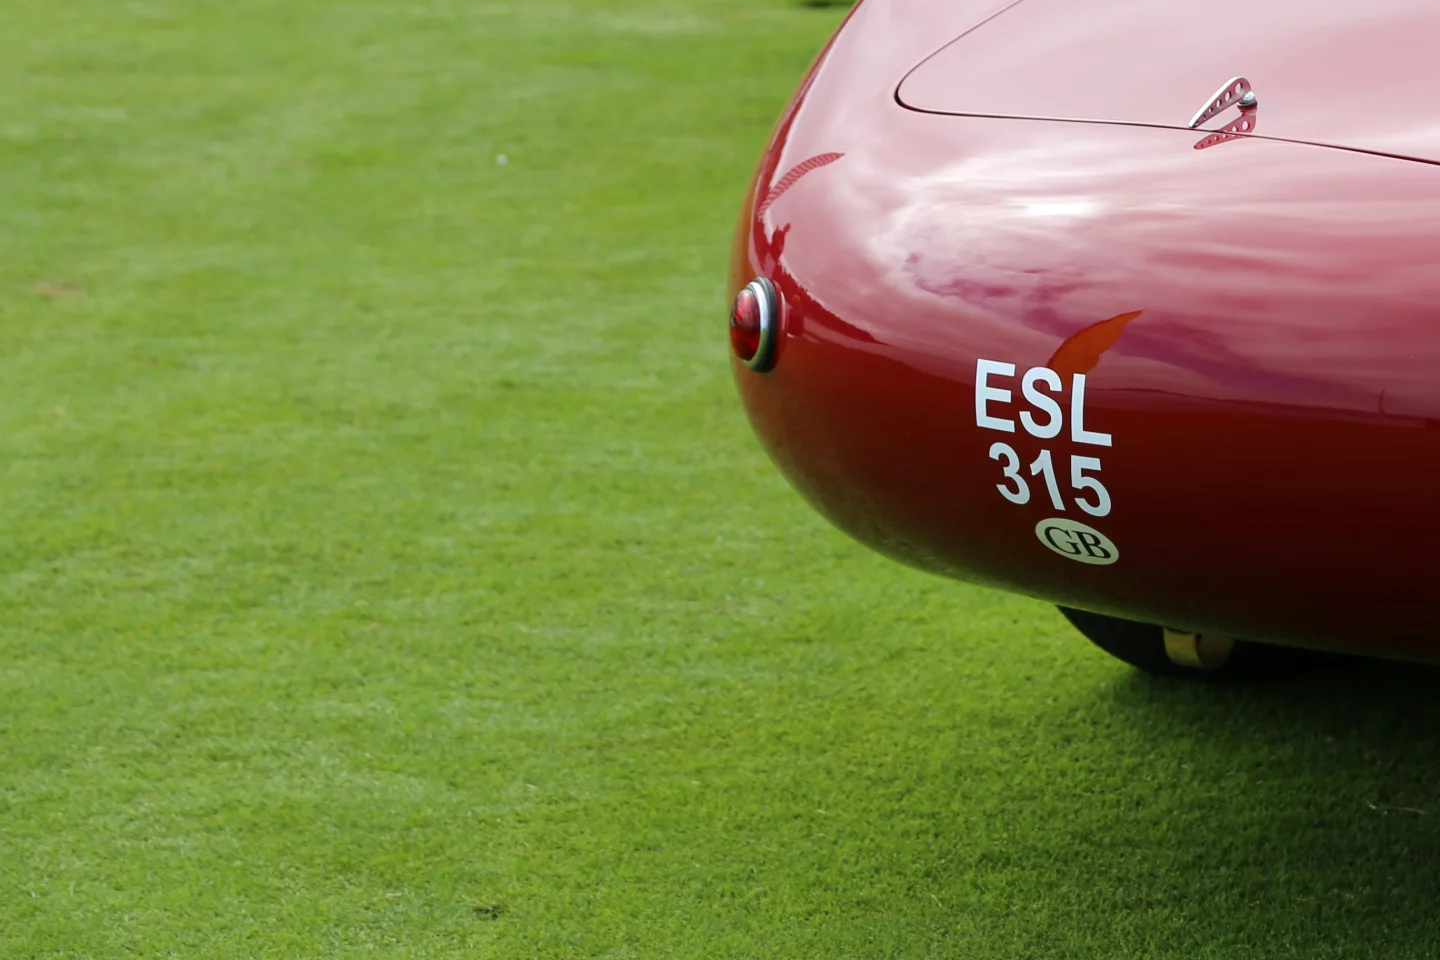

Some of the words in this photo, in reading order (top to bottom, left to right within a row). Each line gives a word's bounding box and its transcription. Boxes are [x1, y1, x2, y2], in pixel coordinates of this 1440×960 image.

[975, 358, 1112, 447] ESL
[989, 442, 1111, 517] 315
[1044, 525, 1112, 559] GB
